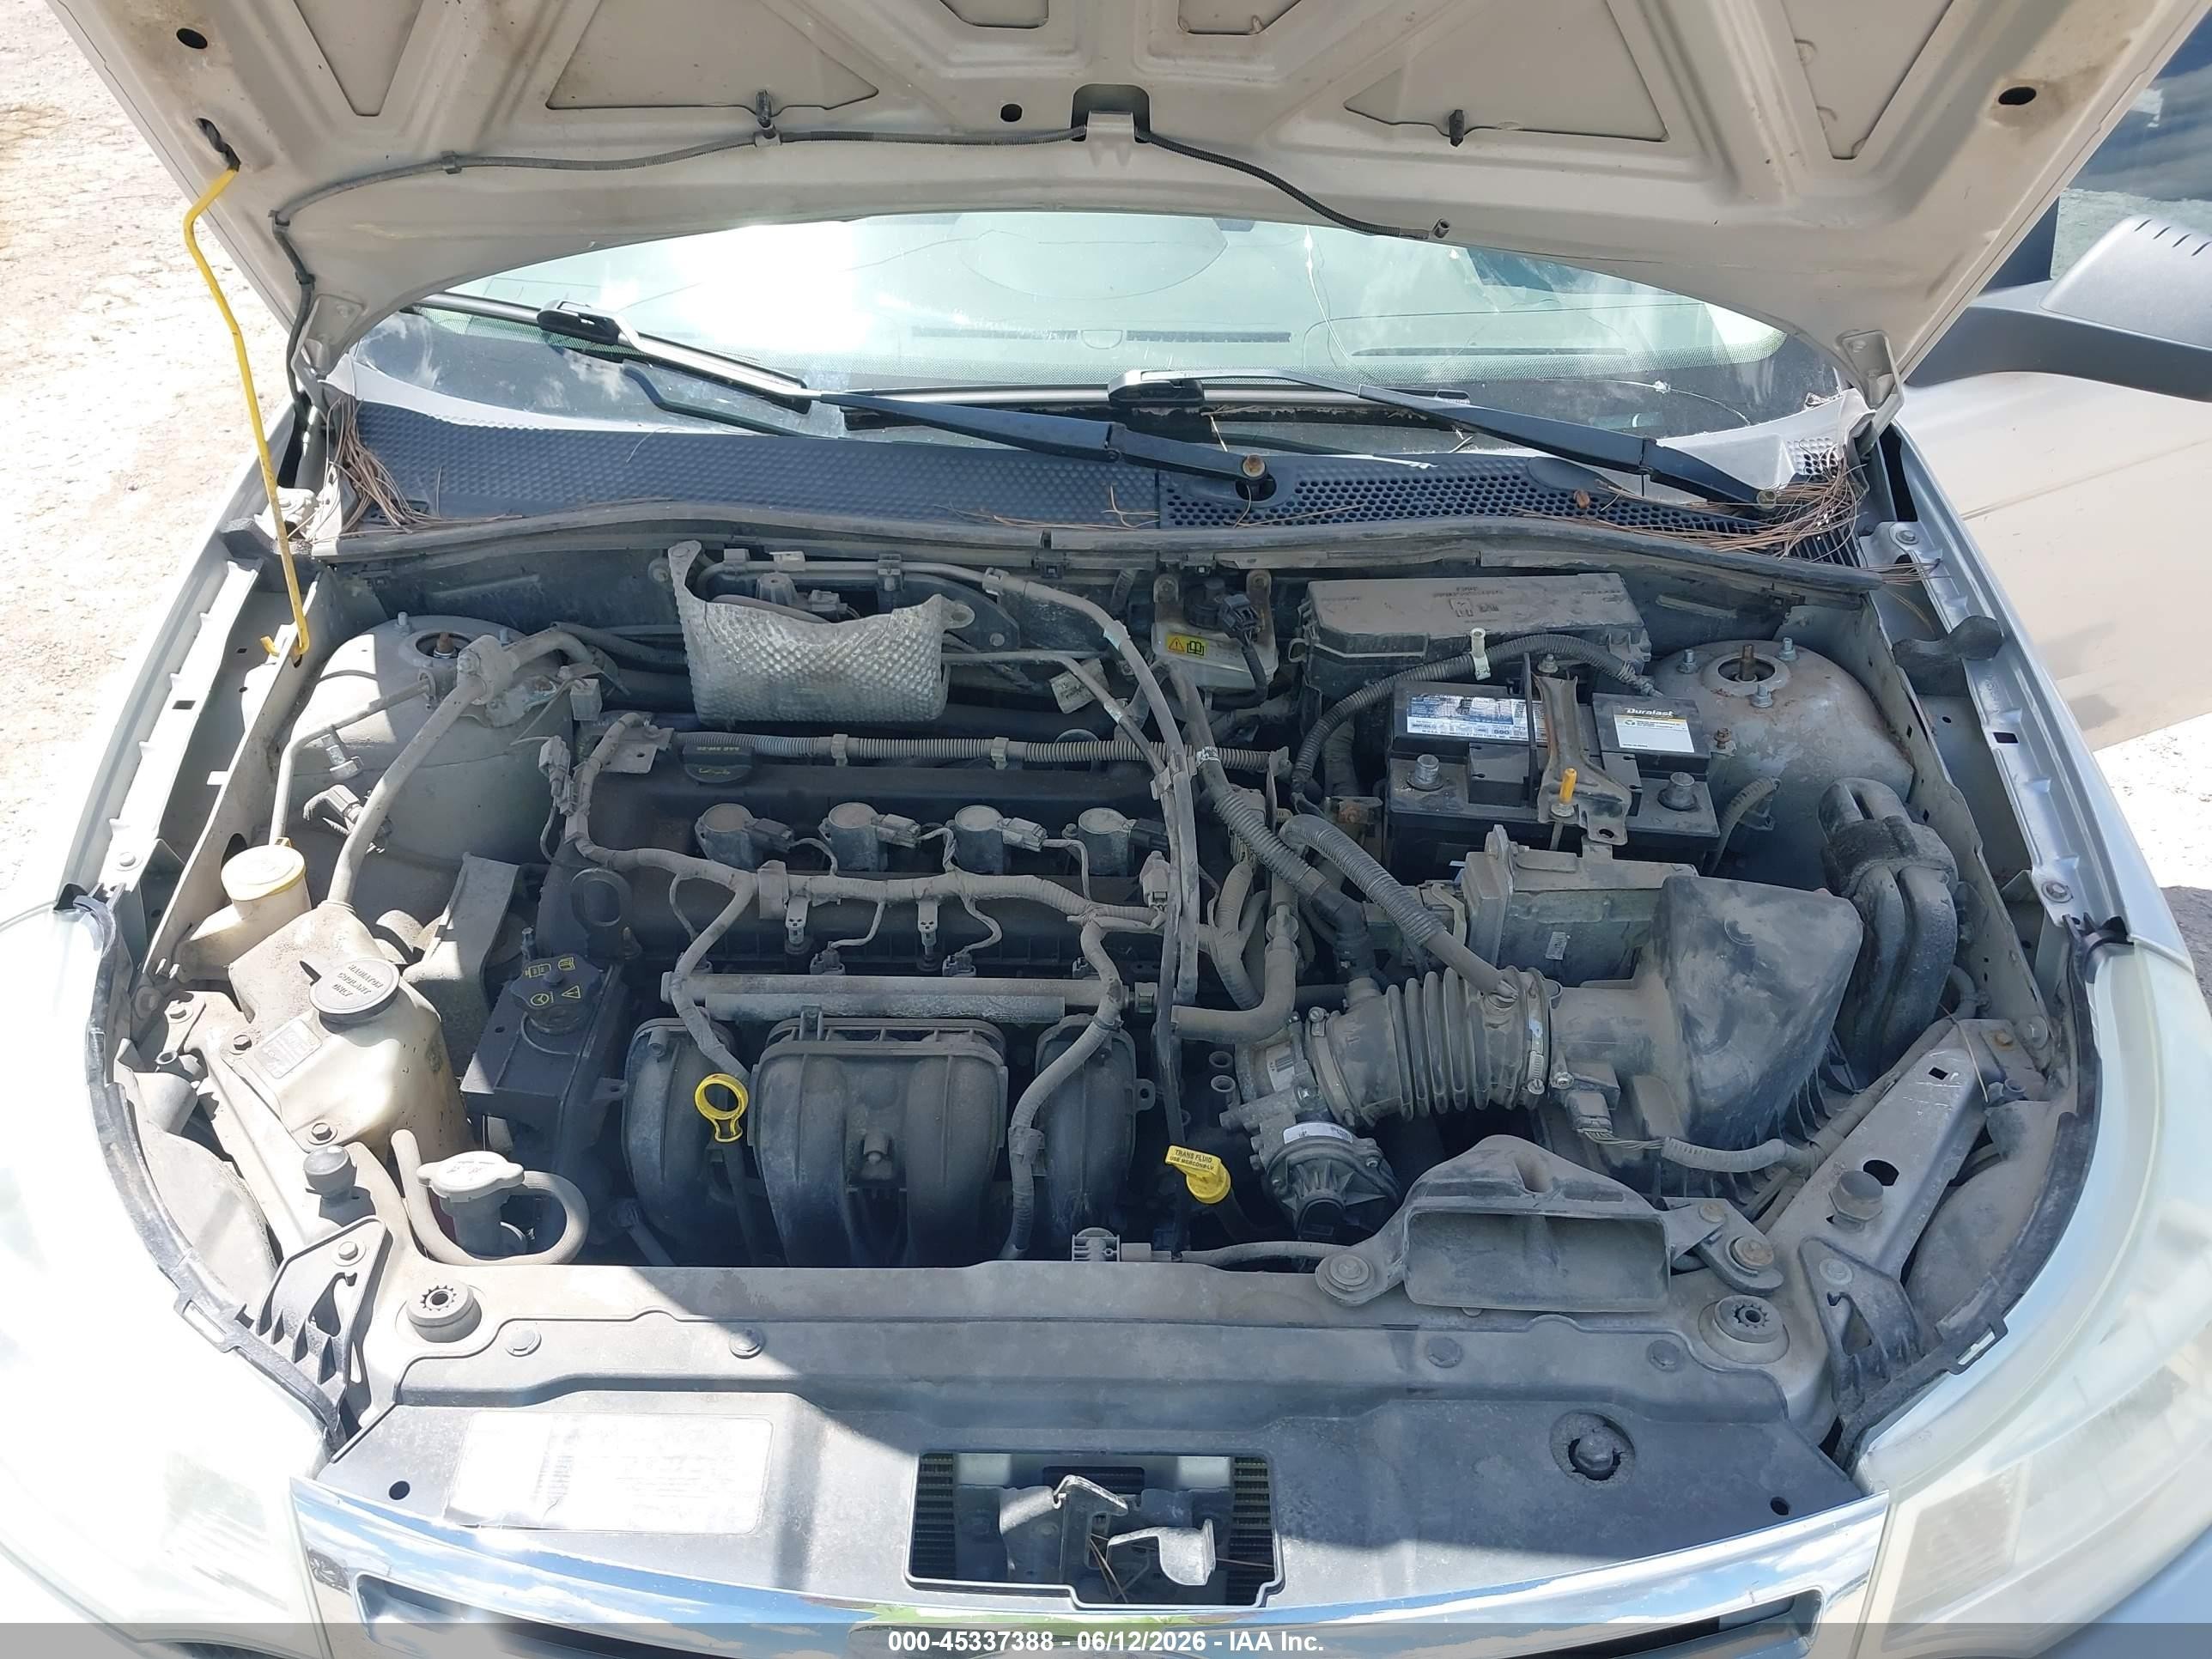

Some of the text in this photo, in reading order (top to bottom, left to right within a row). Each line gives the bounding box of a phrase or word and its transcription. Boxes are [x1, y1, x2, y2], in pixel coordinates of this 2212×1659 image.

[1625, 708, 1674, 716] Duralast
[337, 972, 372, 994] COOLANT
[348, 964, 384, 988] RADIATOR
[331, 984, 353, 996] ONLY
[1175, 1150, 1212, 1164] TRANS FLUID
